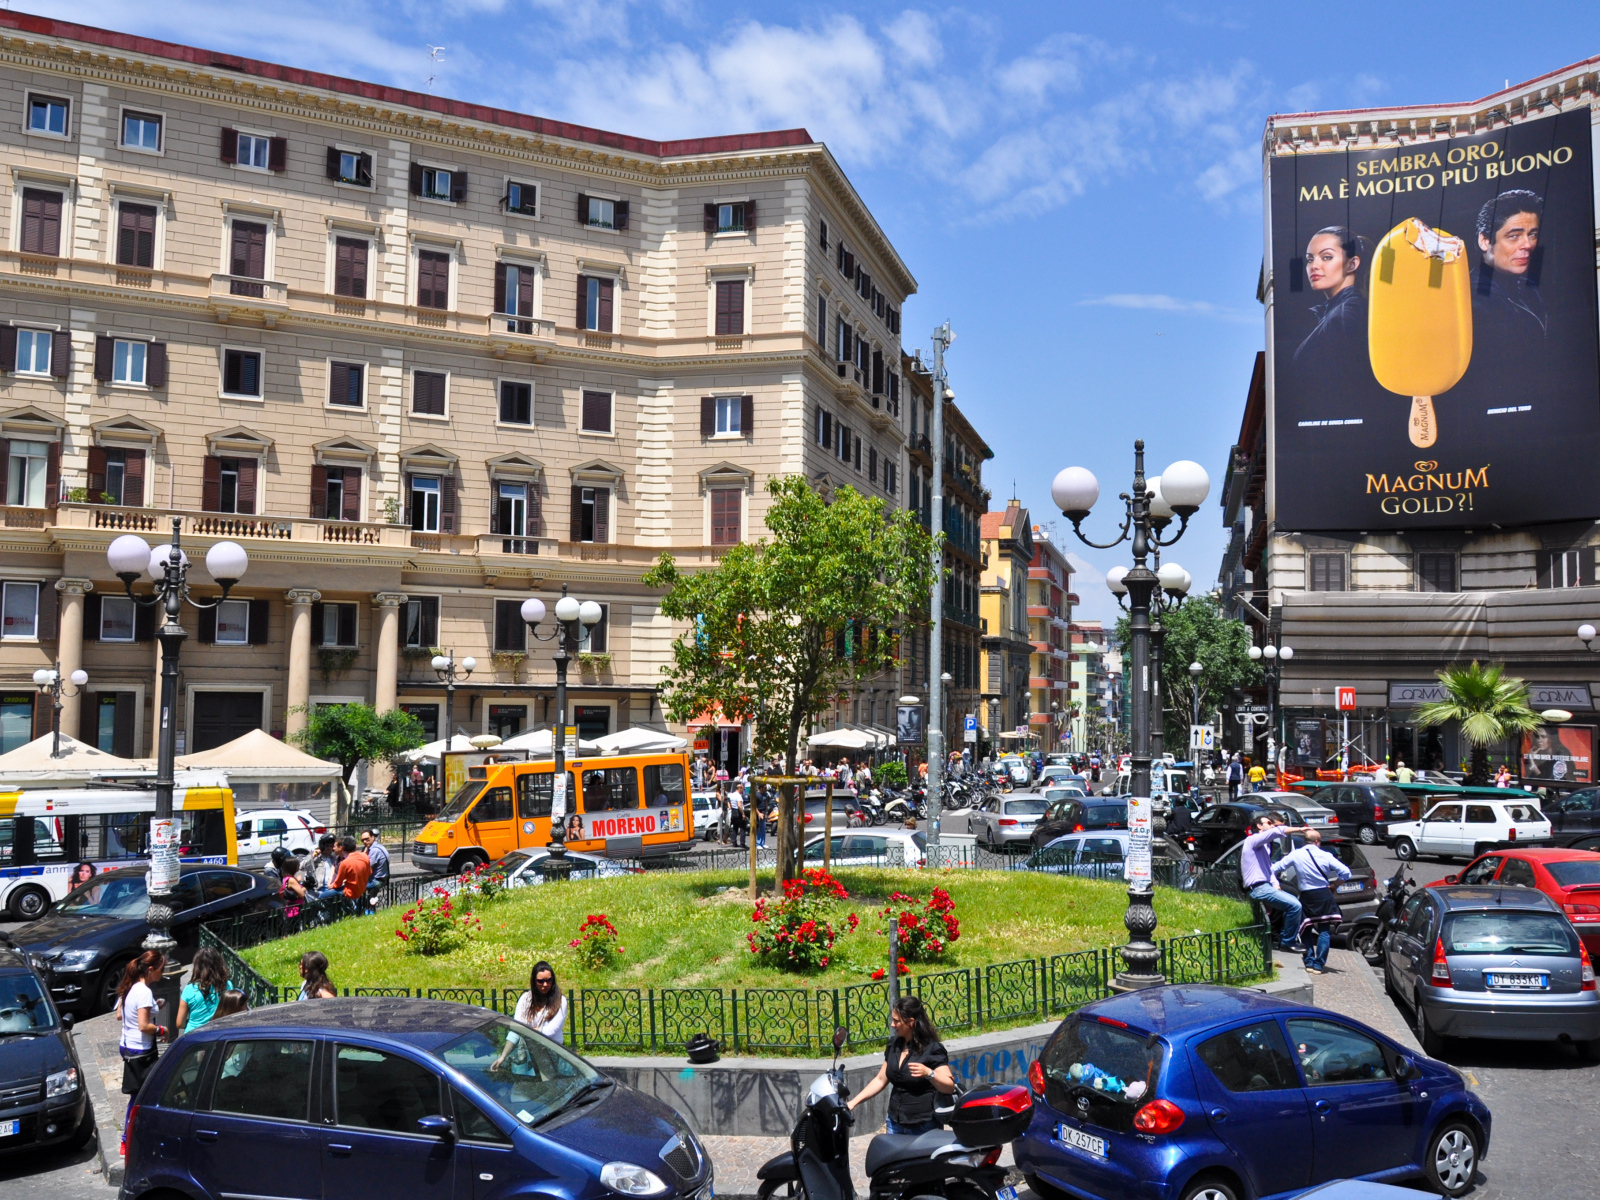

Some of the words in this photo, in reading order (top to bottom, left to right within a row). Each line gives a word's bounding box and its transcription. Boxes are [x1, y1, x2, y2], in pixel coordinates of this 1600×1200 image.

[1357, 151, 1442, 177] SEMBRA
[1447, 141, 1504, 164] ORO,
[1299, 184, 1333, 202] MA
[1339, 178, 1349, 199] È
[1355, 173, 1435, 197] MOLTO
[1442, 162, 1479, 187] PIÙ
[1486, 146, 1573, 180] BUONO
[1365, 466, 1488, 493] MAGNUM
[1381, 492, 1473, 515] GOLD?!
[1342, 692, 1353, 706] M
[966, 719, 974, 729] P
[592, 815, 656, 837] MORENO
[1493, 974, 1505, 984] DY
[1062, 1127, 1073, 1142] DK
[1075, 1132, 1103, 1153] 257CF
